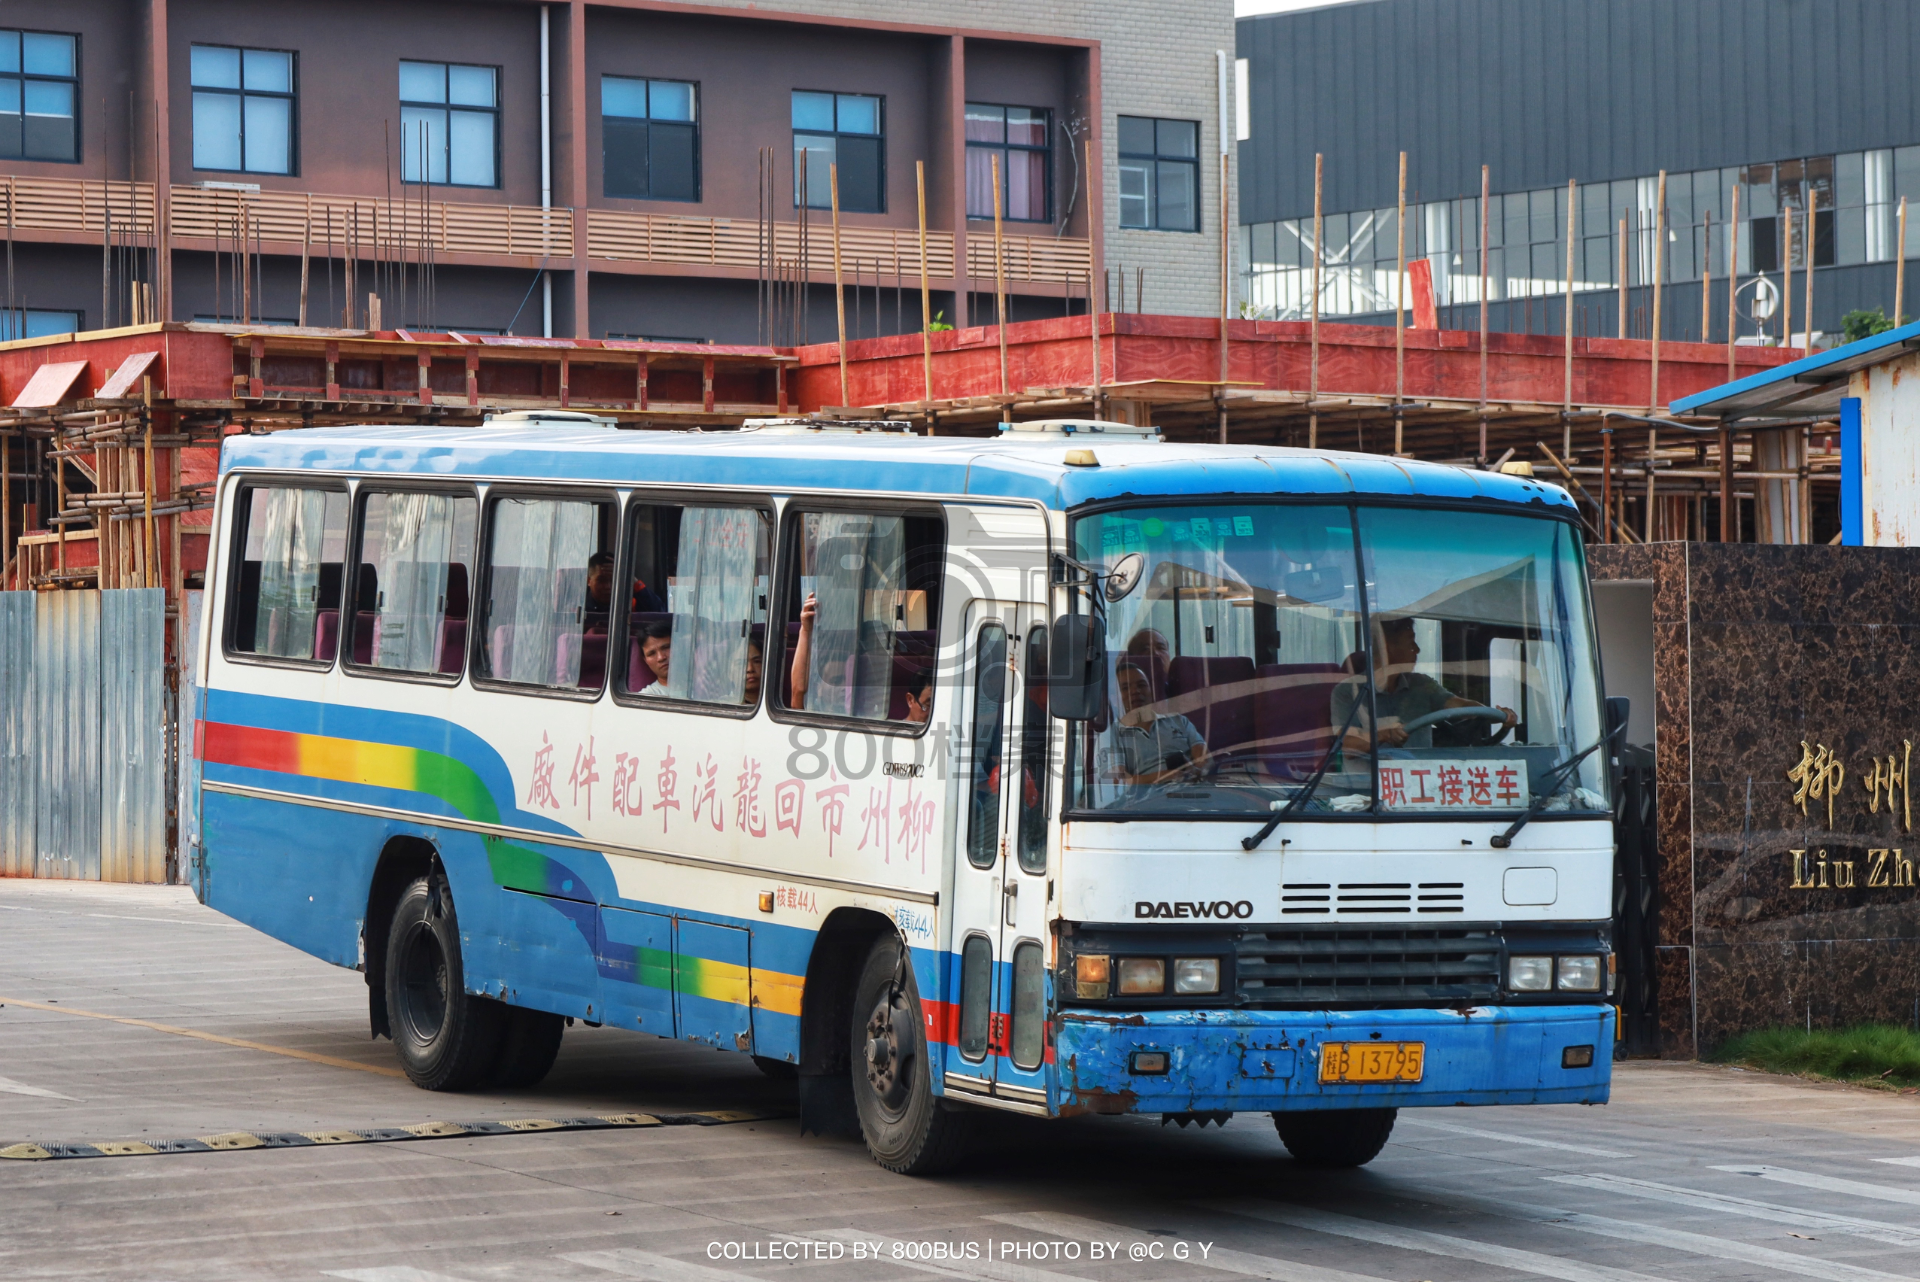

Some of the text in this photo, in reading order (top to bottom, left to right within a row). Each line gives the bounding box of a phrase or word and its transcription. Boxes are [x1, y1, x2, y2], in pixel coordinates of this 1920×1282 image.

[1378, 765, 1520, 807] 职工接送车
[1787, 739, 1912, 832] 柳州
[1789, 848, 1920, 889] Liu Zh
[1135, 900, 1254, 919] DAEWOO
